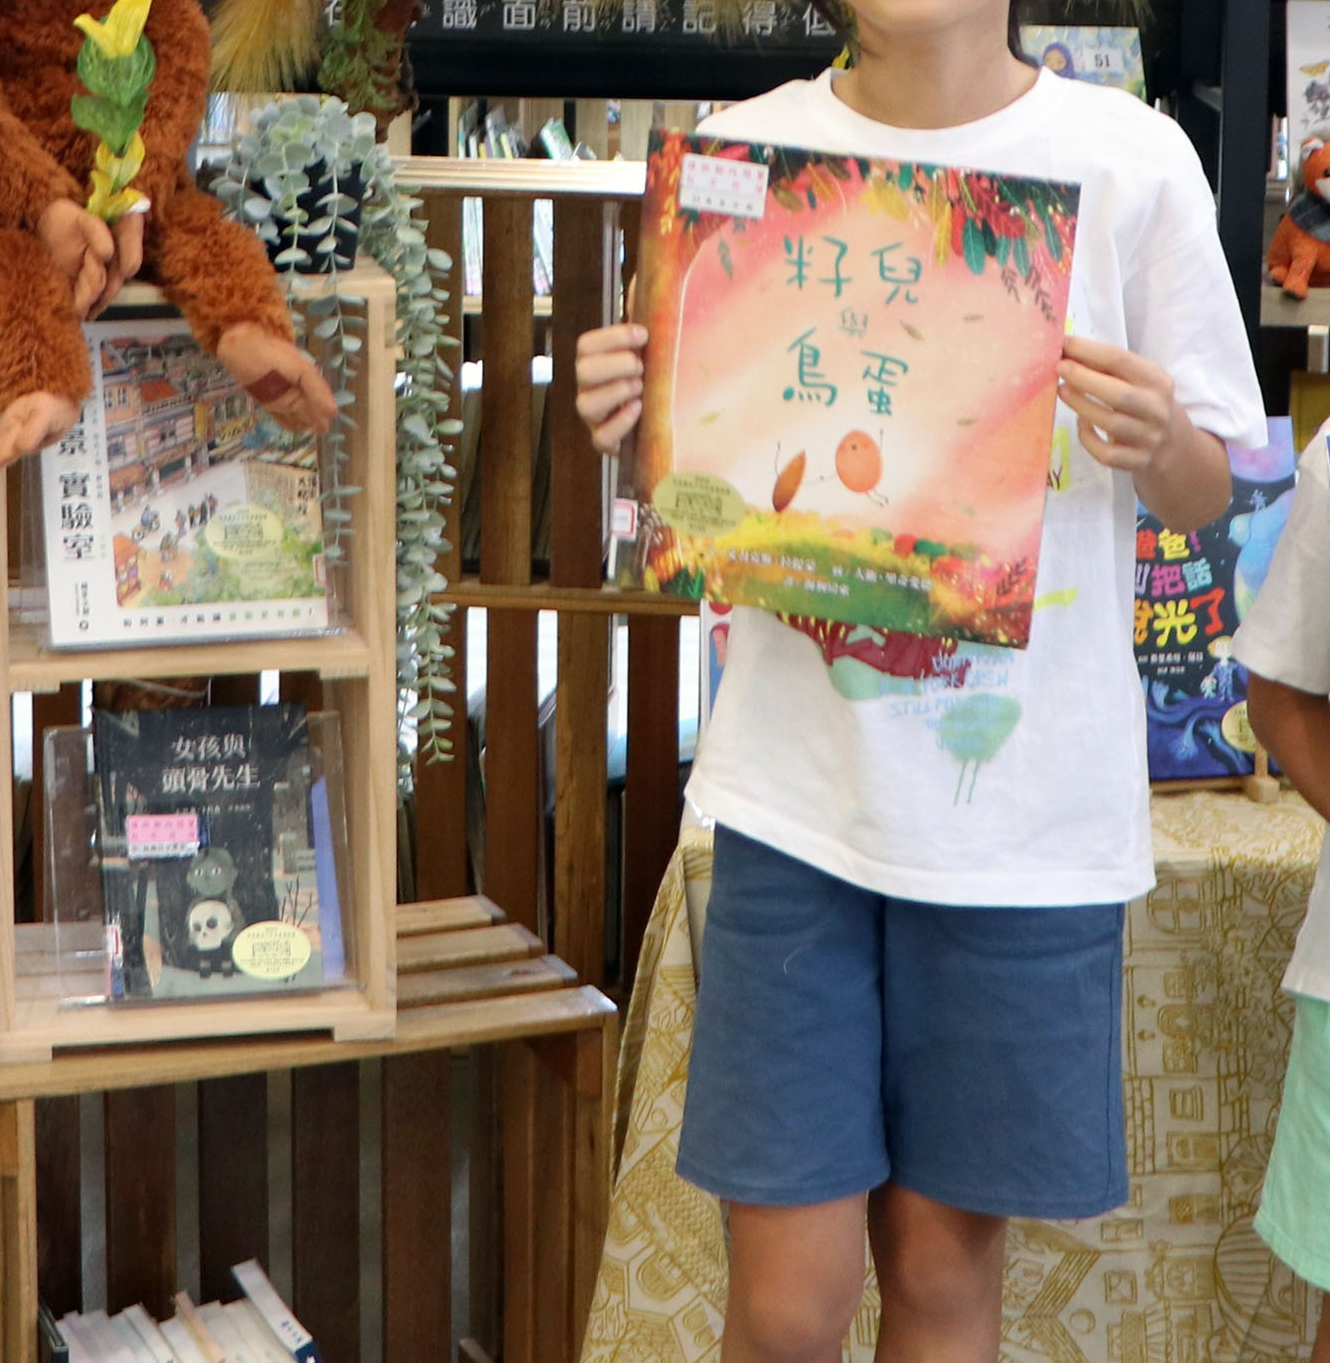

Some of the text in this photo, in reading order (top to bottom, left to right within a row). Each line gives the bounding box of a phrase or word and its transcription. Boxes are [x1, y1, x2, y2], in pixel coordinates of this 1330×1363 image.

[1092, 51, 1112, 69] 51
[781, 234, 923, 305] 籽兒
[782, 327, 910, 417] 鳥蛋
[171, 731, 247, 762] 女孩與
